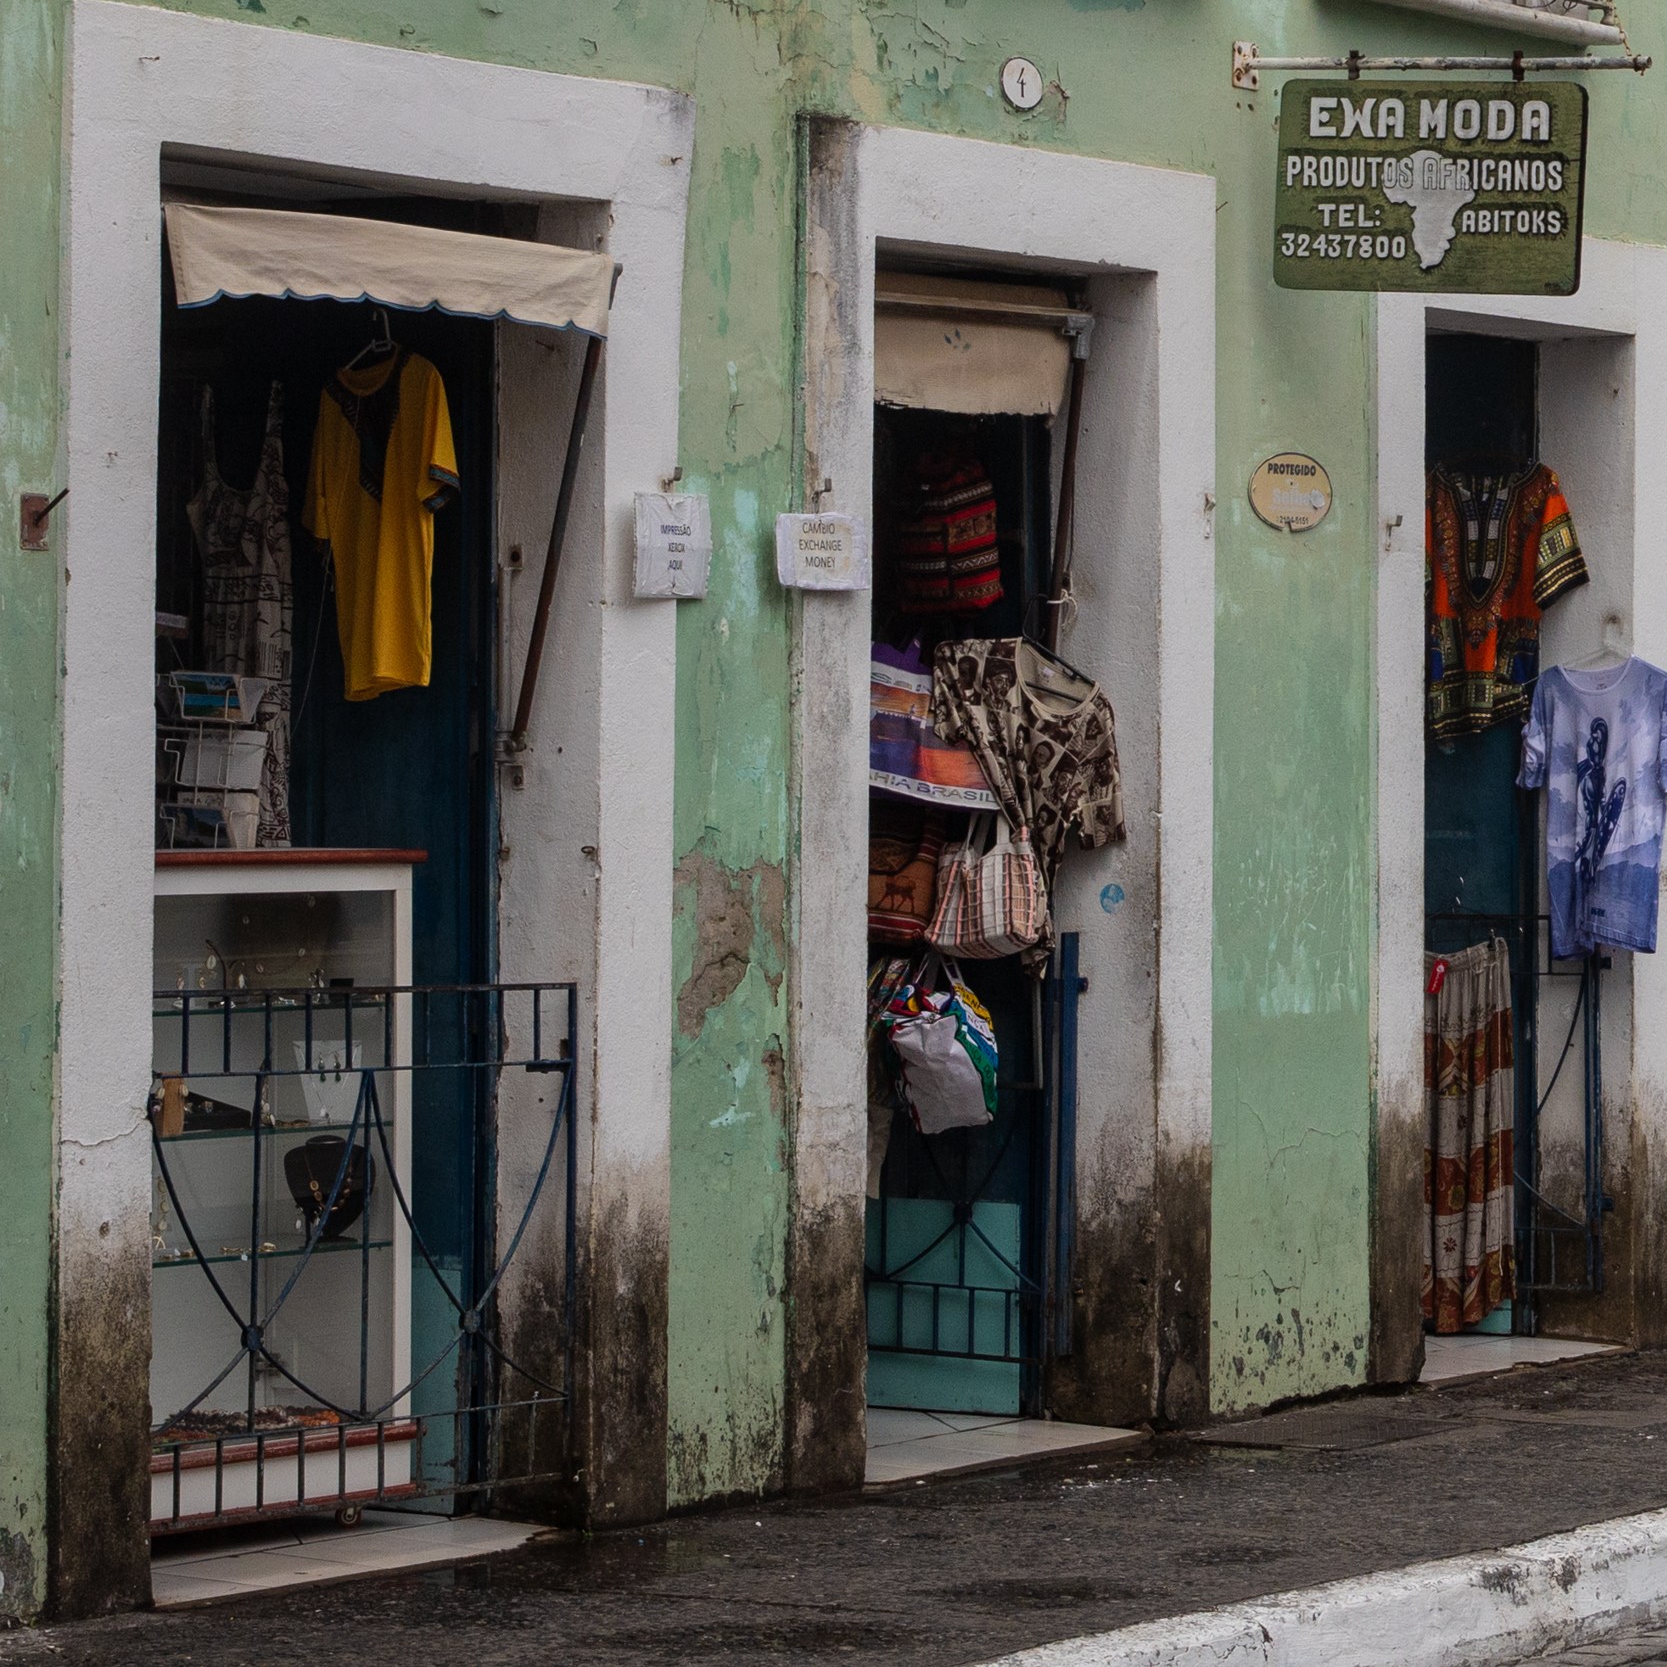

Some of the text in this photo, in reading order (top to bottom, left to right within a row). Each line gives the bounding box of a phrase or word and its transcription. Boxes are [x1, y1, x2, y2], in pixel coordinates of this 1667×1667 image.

[1419, 98, 1550, 141] MODA
[1286, 156, 1563, 192] PRODUTOS AFRICANOS
[1318, 203, 1382, 228] TEL:
[1461, 210, 1562, 234] ABITOKS
[1281, 233, 1406, 259] 32437800
[1267, 463, 1316, 476] PROTEGIDO
[660, 524, 691, 536] IMPRESSÃO
[799, 539, 842, 552] EXCHANGE
[805, 556, 836, 568] MONEY
[917, 781, 996, 803] BRASIL
